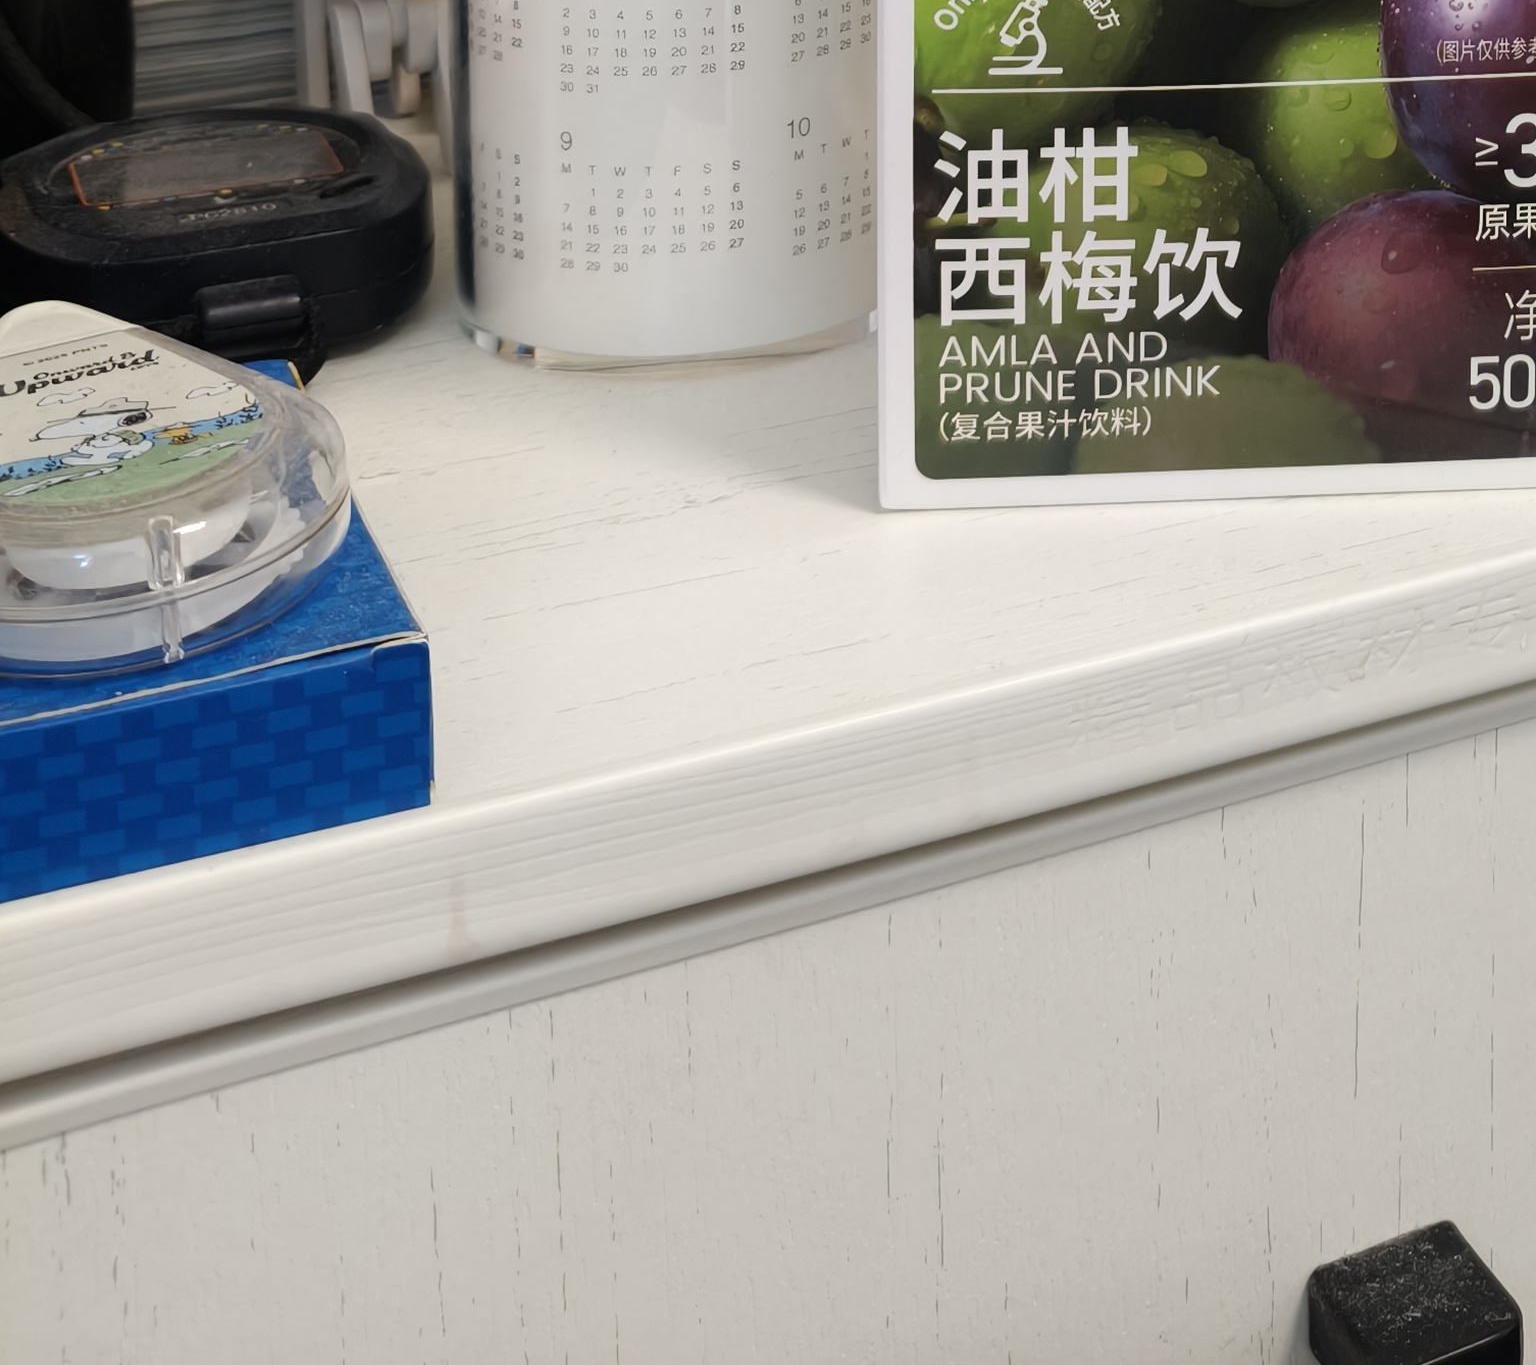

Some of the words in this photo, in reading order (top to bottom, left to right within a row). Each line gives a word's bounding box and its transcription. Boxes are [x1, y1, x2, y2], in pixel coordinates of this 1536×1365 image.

[563, 8, 570, 19] 2
[589, 9, 597, 20] 3
[617, 11, 624, 20] 4
[646, 10, 654, 21] 5
[675, 9, 683, 20] 6
[705, 8, 713, 18] 7
[734, 5, 742, 16] 8
[563, 26, 570, 37] 9
[587, 28, 600, 39] 10
[617, 30, 627, 40] 11
[644, 29, 657, 40] 12
[674, 28, 687, 38] 13
[703, 26, 715, 37] 14
[732, 23, 745, 34] 15
[562, 45, 573, 56] 16
[588, 47, 600, 57] 17
[615, 48, 628, 59] 18
[644, 48, 657, 59] 19
[672, 47, 688, 58] 20
[701, 45, 715, 56] 21
[731, 42, 746, 53] 22
[561, 63, 574, 74] 23
[586, 66, 600, 76] 24
[614, 67, 629, 77] 25
[642, 66, 658, 77] 26
[672, 66, 688, 76] 27
[701, 63, 717, 74] 28
[730, 60, 746, 71] 29
[560, 81, 574, 93] 30
[587, 84, 599, 94] 31
[561, 132, 573, 152] 9
[562, 163, 572, 174] M
[589, 165, 597, 176] T
[614, 167, 627, 177] W
[645, 166, 653, 177] T
[674, 166, 682, 177] F
[703, 163, 712, 175] S
[732, 160, 741, 171] S
[934, 126, 1139, 224] 油柑
[591, 188, 596, 197] 1
[617, 189, 624, 199] 2
[646, 189, 653, 200] 3
[674, 188, 682, 197] 4
[704, 186, 712, 196] 5
[733, 183, 741, 193] 6
[563, 203, 570, 214] 7
[589, 206, 597, 216] 8
[617, 207, 625, 218] 9
[643, 207, 657, 218] 10
[674, 207, 685, 216] 11
[702, 204, 715, 215] 12
[731, 200, 744, 211] 13
[562, 222, 573, 233] 14
[588, 225, 600, 235] 15
[615, 226, 628, 236] 16
[644, 226, 656, 236] 17
[673, 225, 686, 235] 18
[703, 222, 715, 233] 19
[730, 219, 745, 230] 20
[561, 240, 573, 251] 21
[586, 243, 601, 253] 22
[613, 244, 628, 255] 23
[642, 244, 657, 255] 24
[671, 243, 687, 254] 25
[701, 241, 716, 252] 26
[730, 238, 745, 249] 27
[561, 258, 575, 269] 28
[586, 261, 601, 272] 29
[614, 262, 629, 273] 30
[935, 227, 1244, 326] 西梅饮
[939, 334, 1058, 368] AMLA
[1075, 331, 1168, 364] AND
[939, 369, 1077, 404] PRUNE
[1095, 365, 1220, 401] DRINK
[938, 406, 1152, 443] (复合果汁饮料)
